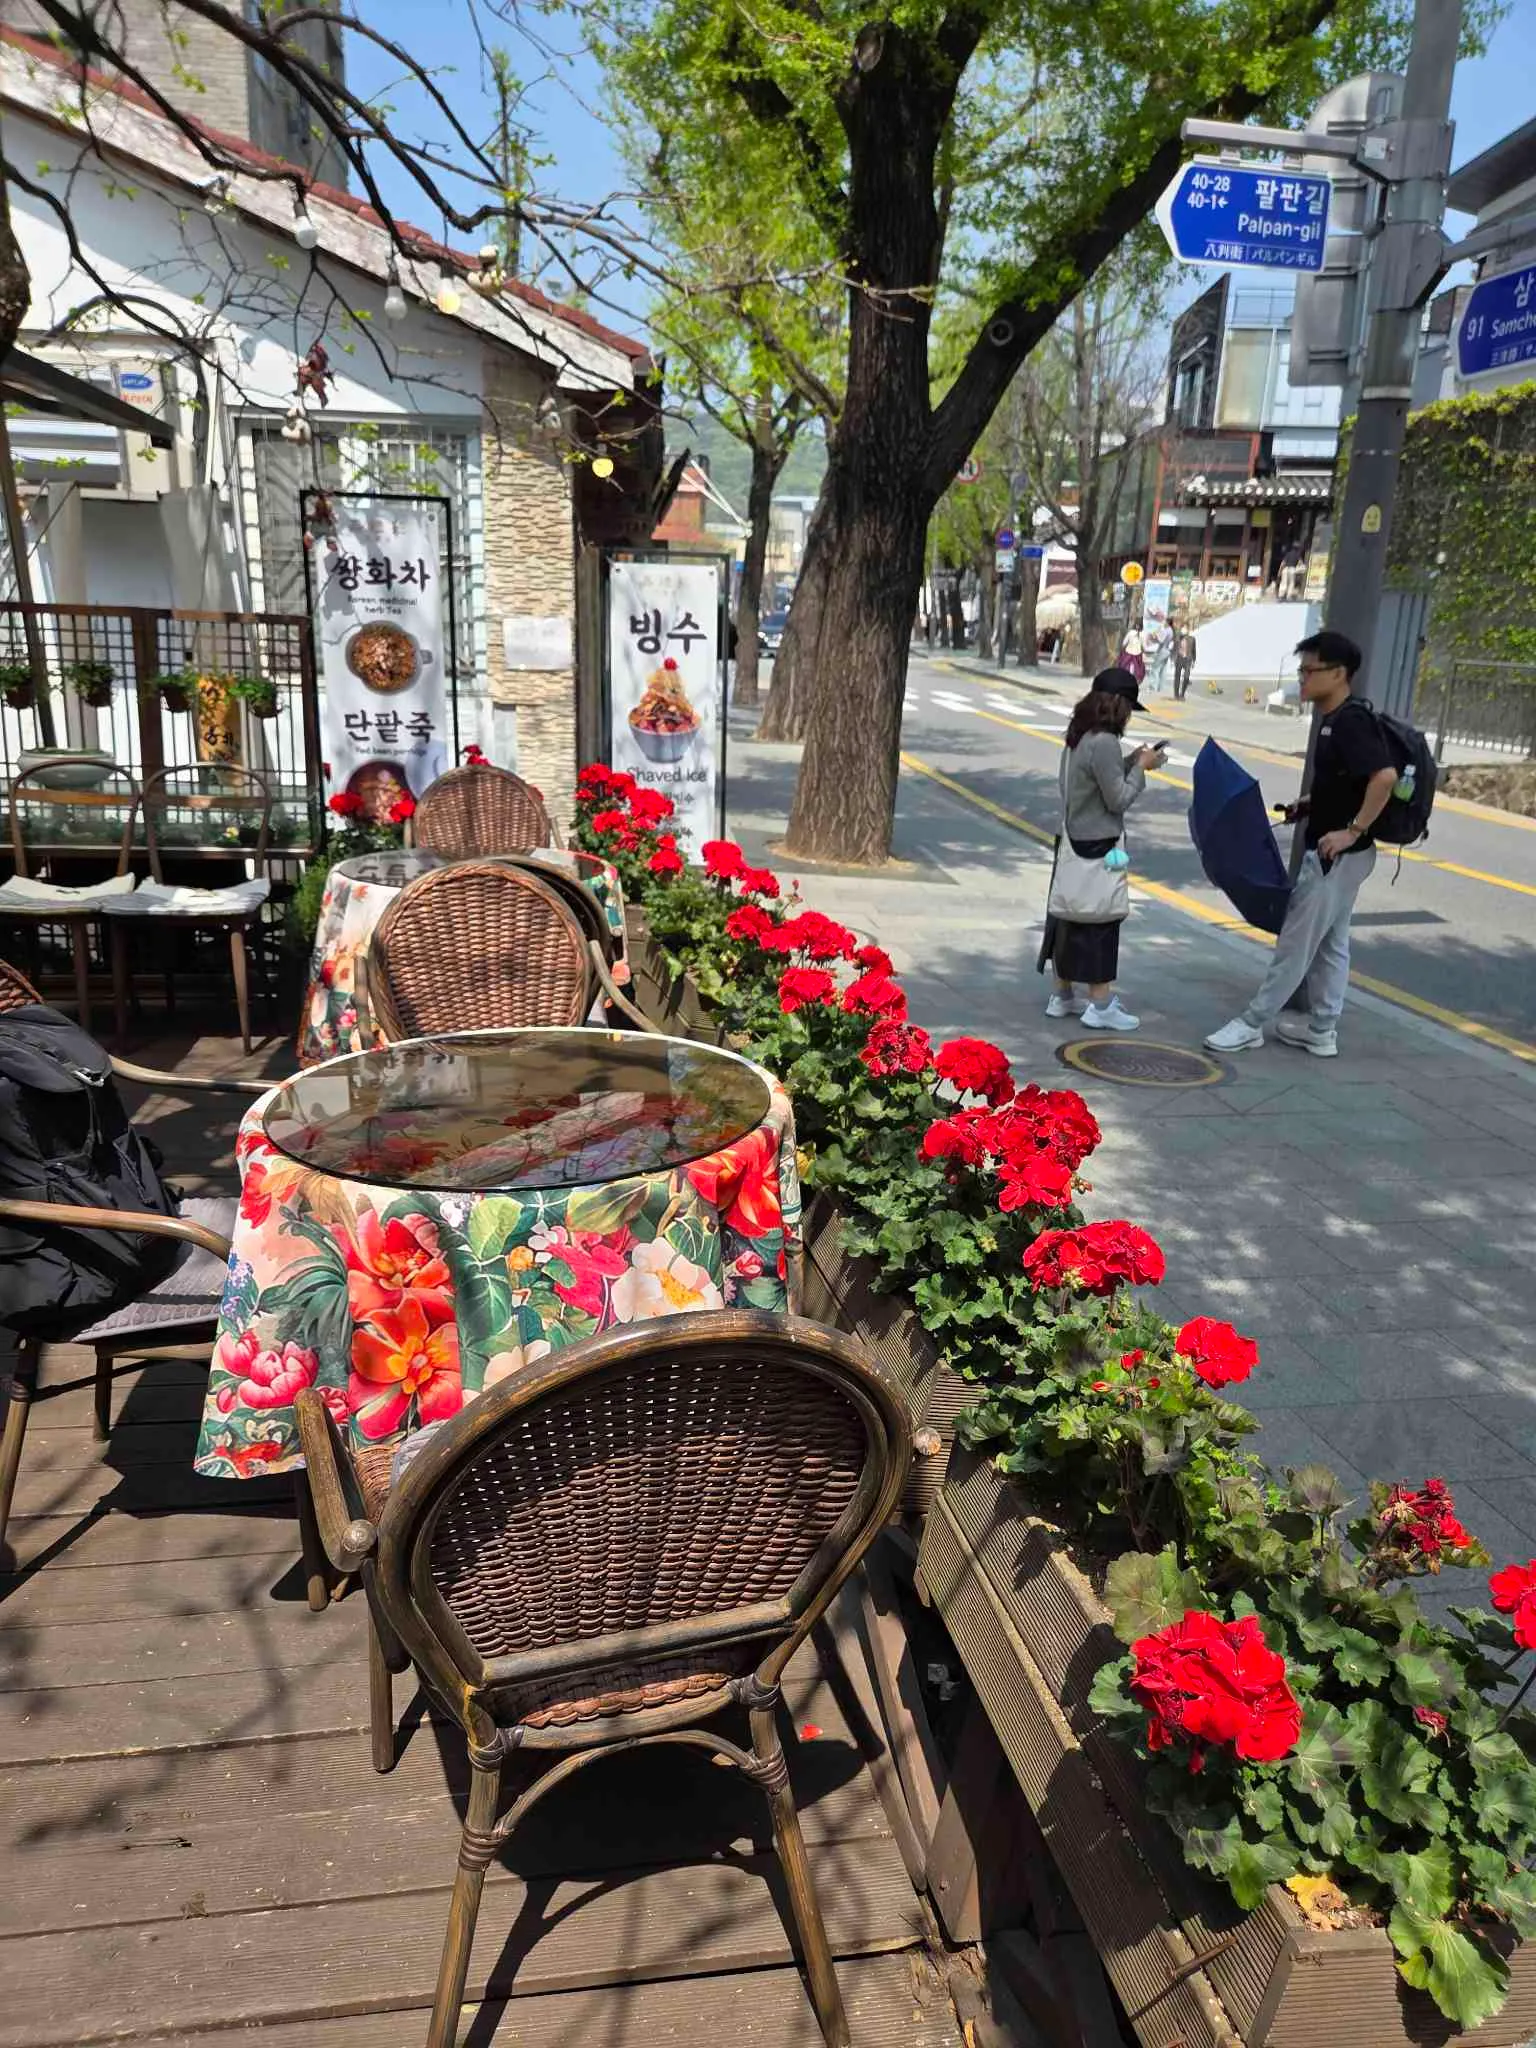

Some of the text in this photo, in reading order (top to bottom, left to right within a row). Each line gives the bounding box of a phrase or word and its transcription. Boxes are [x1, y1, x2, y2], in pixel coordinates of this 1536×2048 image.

[1191, 173, 1231, 192] 40-28
[1255, 179, 1326, 216] 팔판길
[1187, 192, 1217, 210] 40-1
[1237, 213, 1321, 243] Palpan-gil
[1467, 315, 1484, 341] 91
[331, 555, 431, 592] 쌍화차
[630, 608, 707, 656] 빙수
[344, 709, 436, 744] 단팥죽
